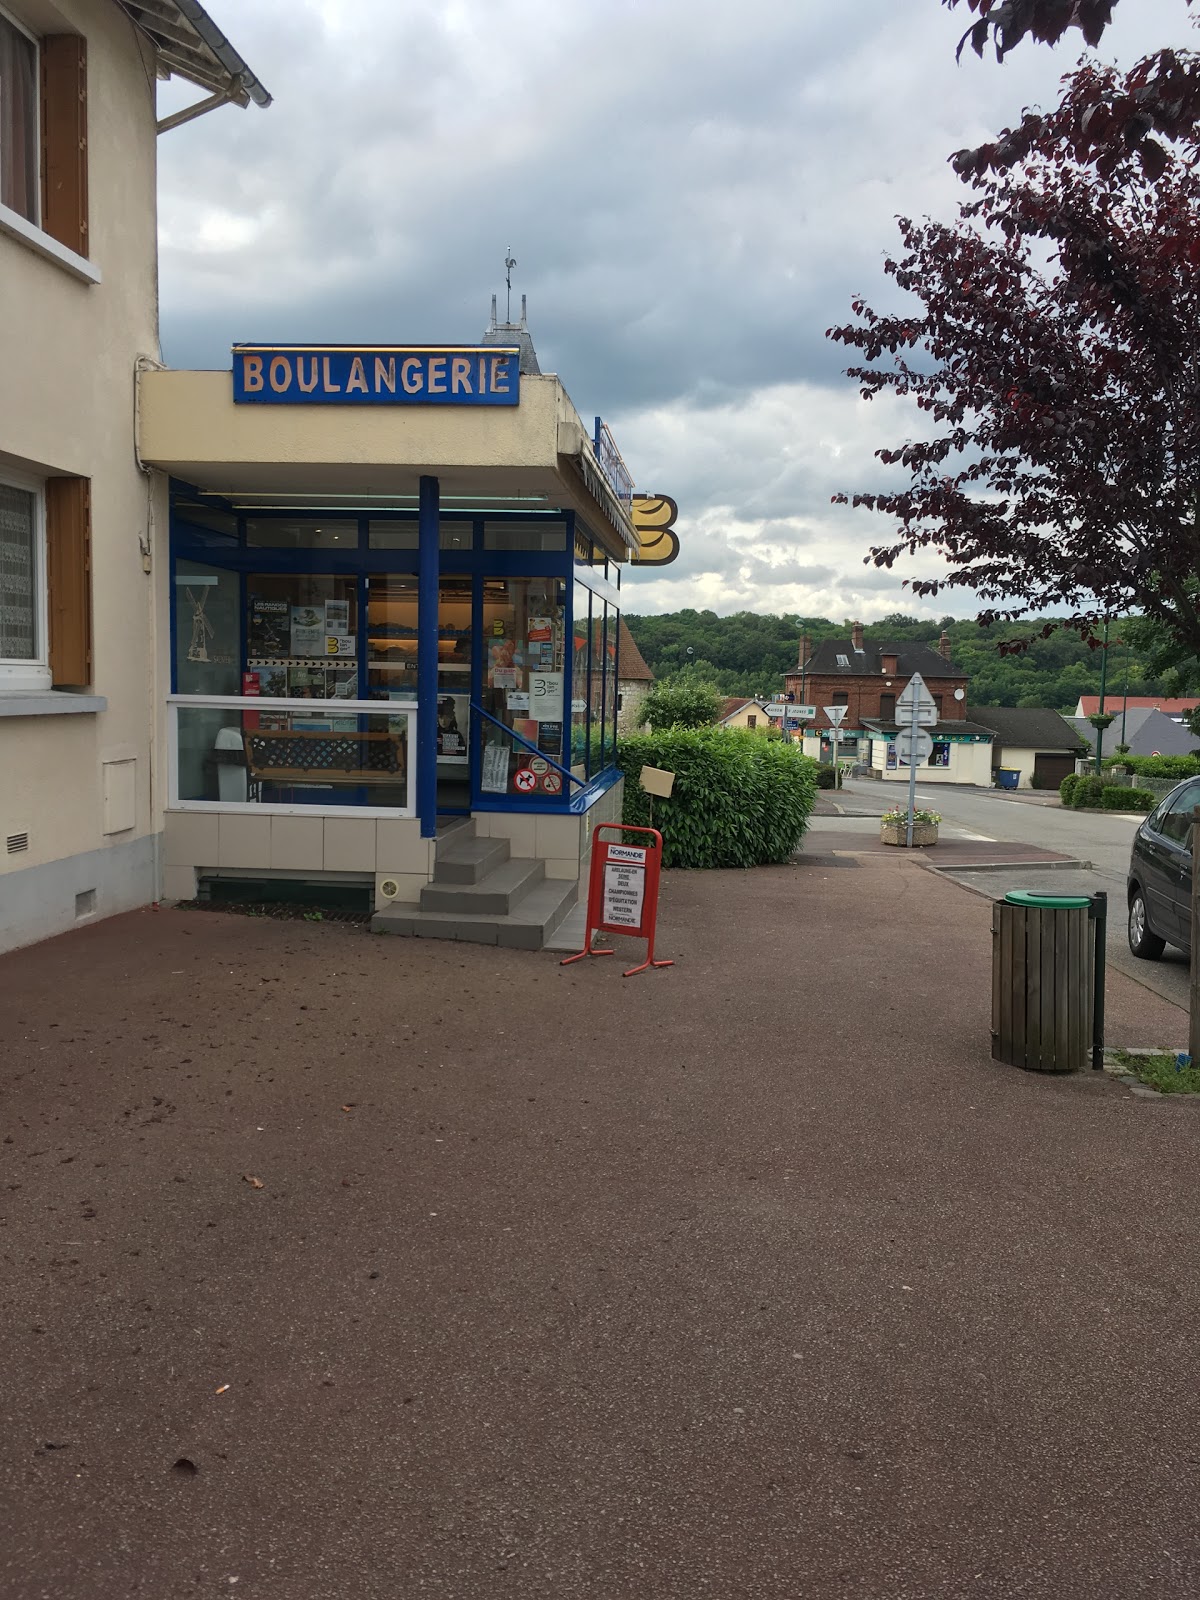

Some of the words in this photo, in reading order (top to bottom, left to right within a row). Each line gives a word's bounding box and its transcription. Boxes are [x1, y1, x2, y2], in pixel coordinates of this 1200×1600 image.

[243, 355, 510, 395] BOULANGERIE
[610, 849, 643, 859] NORMANDIE
[609, 915, 636, 923] NORMANDIE
